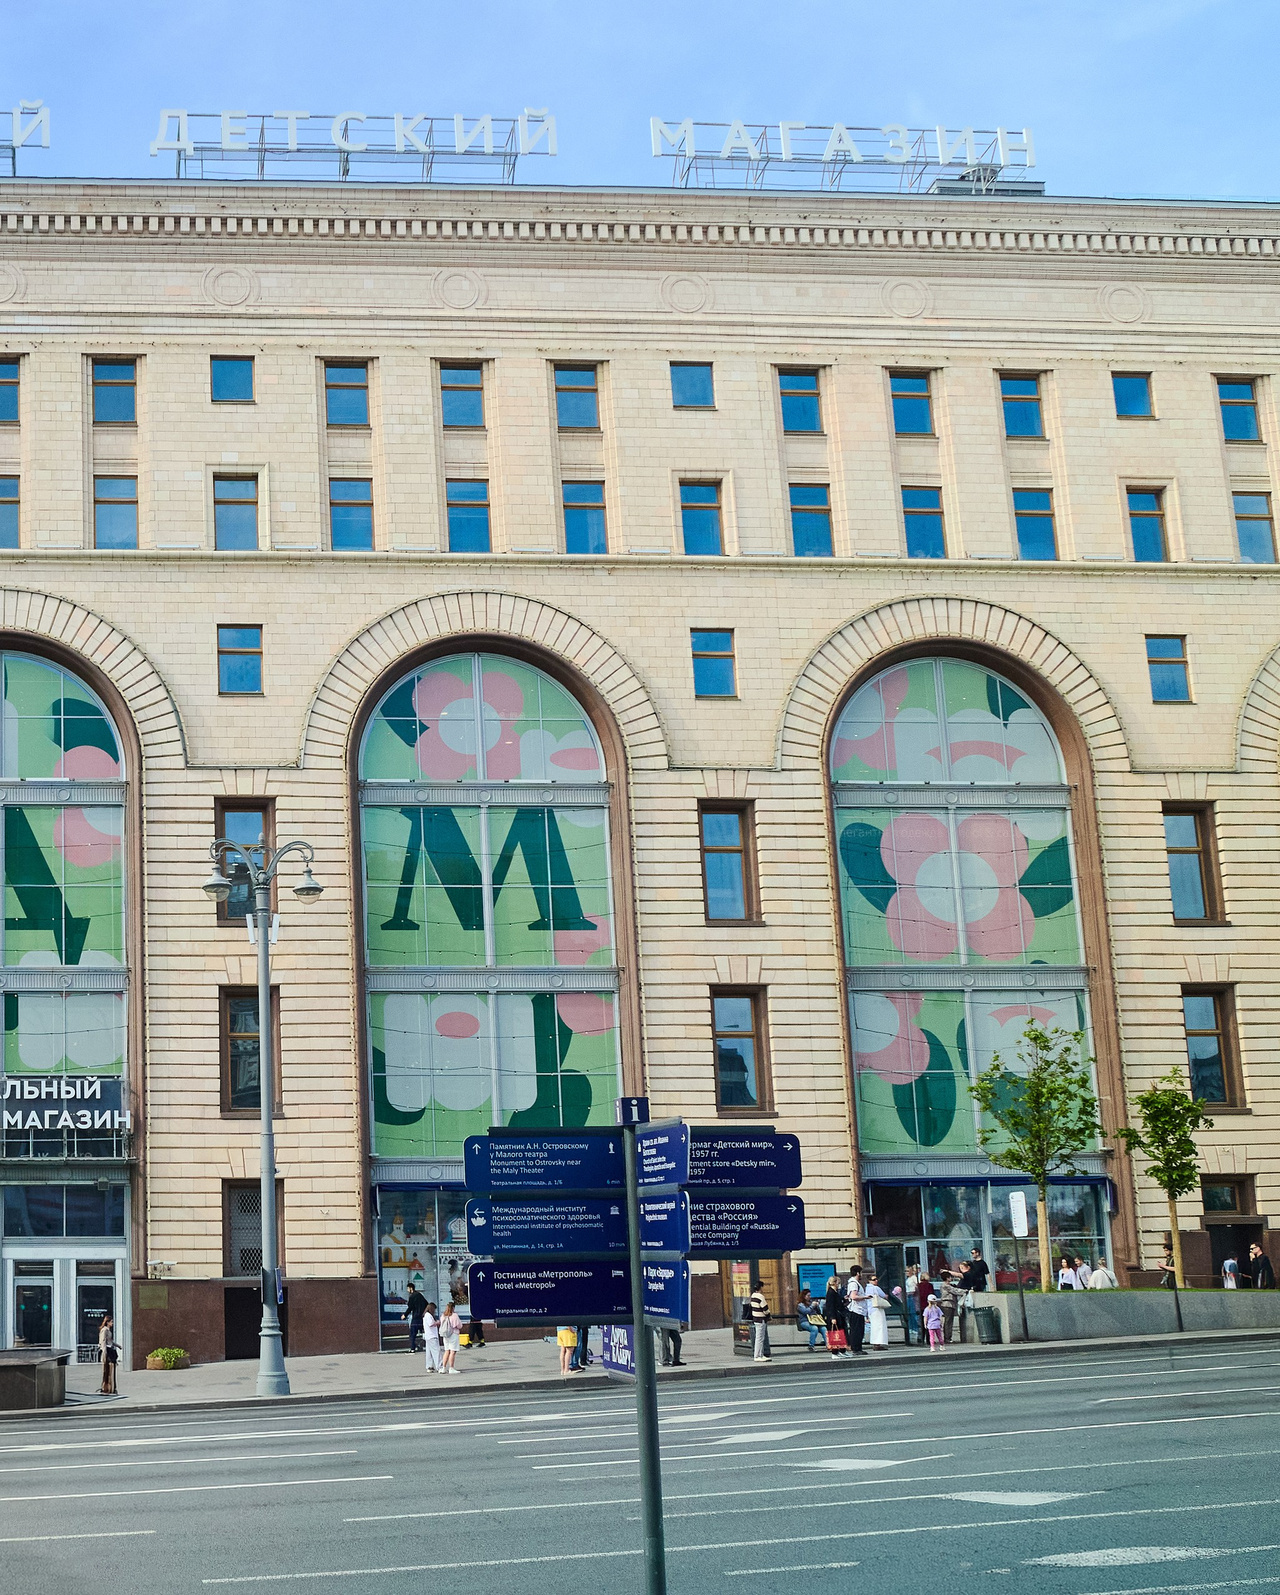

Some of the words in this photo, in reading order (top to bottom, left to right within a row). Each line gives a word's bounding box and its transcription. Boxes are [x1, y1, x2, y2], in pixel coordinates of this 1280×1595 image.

[150, 108, 557, 156] ДЕТСКИЙ
[651, 117, 1037, 168] МАГАЗИН
[3, 1110, 131, 1130] МАГАЗИН
[542, 1143, 589, 1151] Островскому
[713, 1141, 750, 1149] «Детский
[751, 1142, 775, 1150] мир»,
[534, 1159, 566, 1167] Ostrovsky
[731, 1160, 757, 1168] «Detsky
[502, 1167, 518, 1175] Maly
[492, 1205, 554, 1214] Международный
[555, 1205, 586, 1213] институт
[706, 1203, 755, 1212] страхового
[492, 1214, 566, 1222] психосоматического
[567, 1213, 601, 1221] здоровья
[717, 1212, 758, 1221] «Россия»
[712, 1223, 740, 1231] Building
[750, 1222, 780, 1230] «Russia»
[708, 1232, 739, 1240] Company
[493, 1271, 536, 1279] Гостиница
[538, 1270, 593, 1279] «Метрополь»
[515, 1281, 556, 1290] «Metropol»
